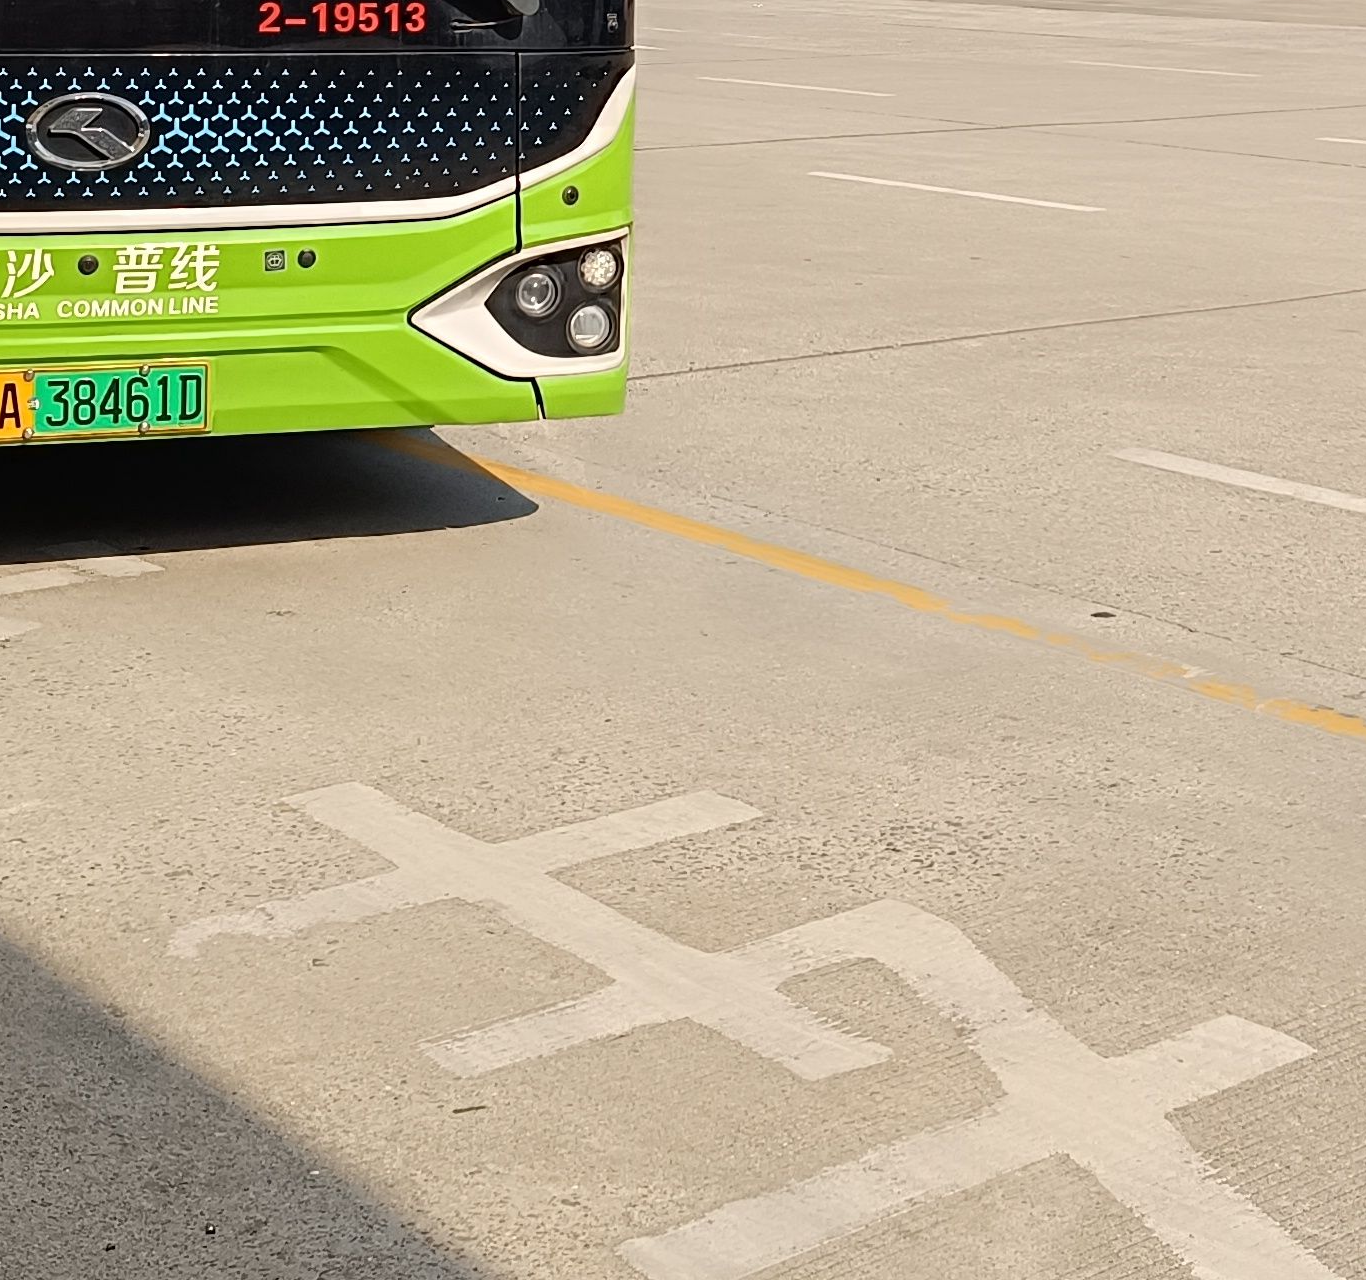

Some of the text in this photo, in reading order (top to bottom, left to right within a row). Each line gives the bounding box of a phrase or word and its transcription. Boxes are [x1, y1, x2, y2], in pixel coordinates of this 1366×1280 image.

[258, 1, 426, 32] 2-19513
[112, 242, 221, 294] 普线
[56, 297, 164, 319] COMMON
[168, 296, 219, 315] LINE
